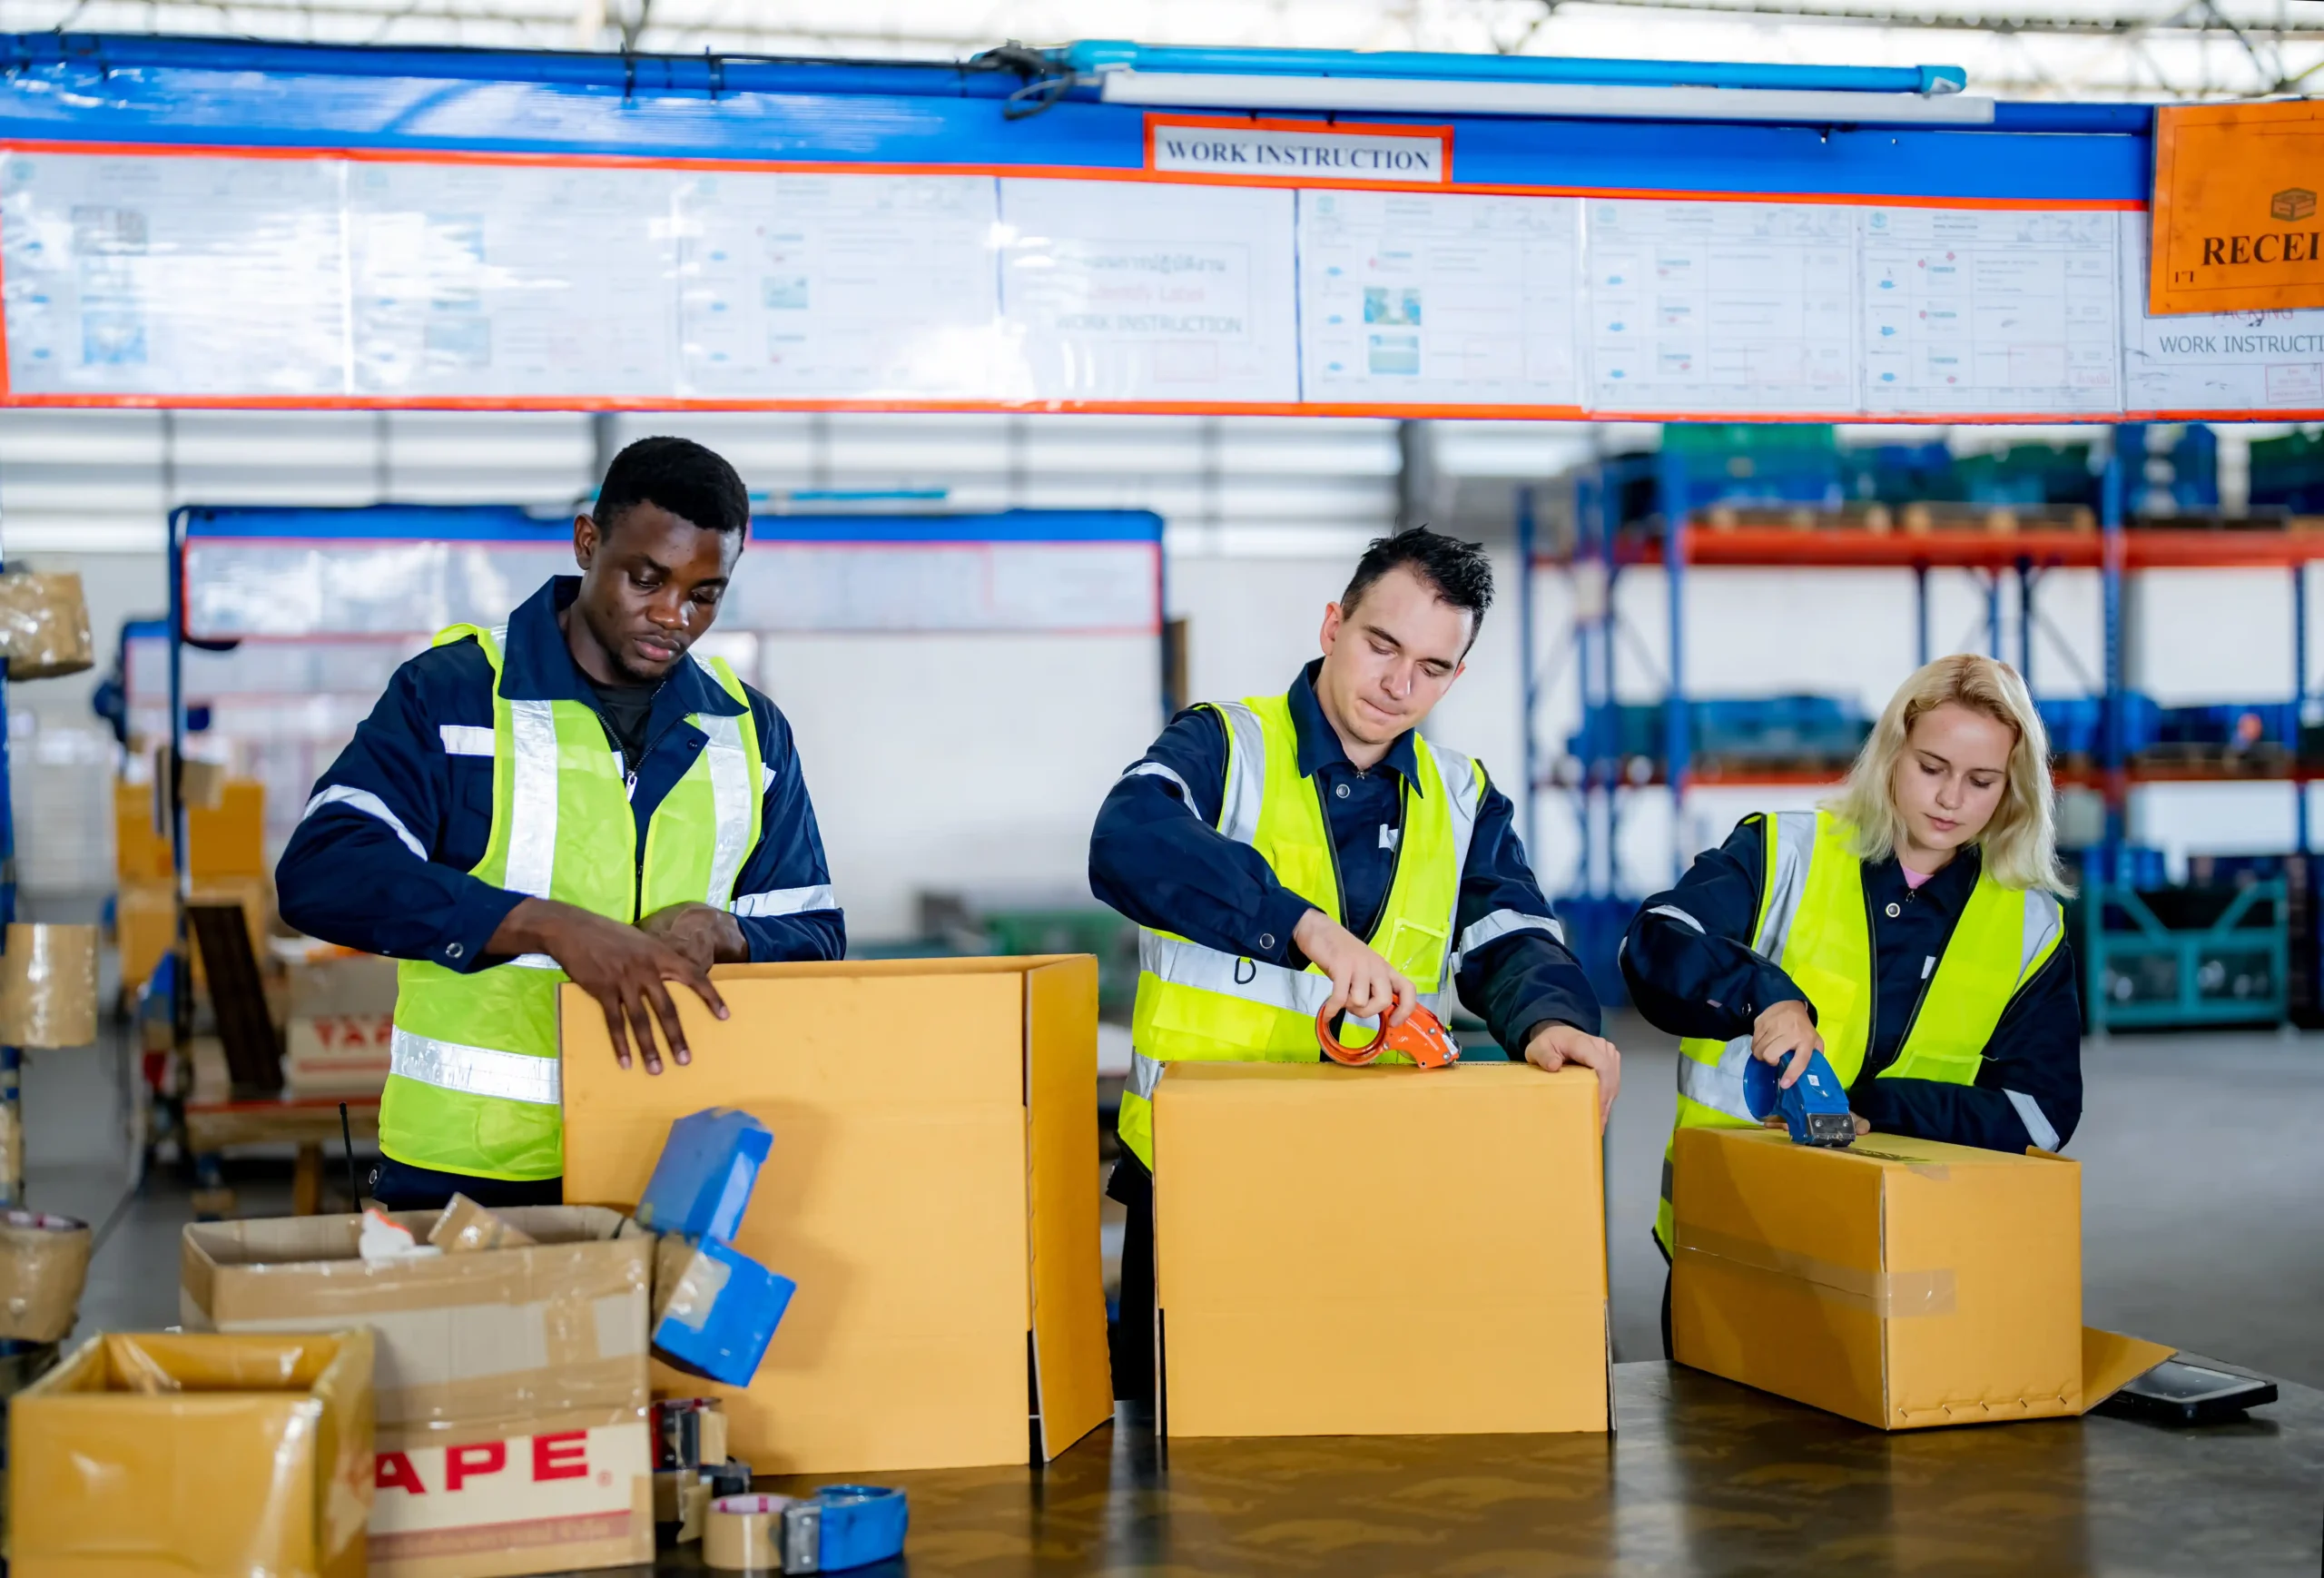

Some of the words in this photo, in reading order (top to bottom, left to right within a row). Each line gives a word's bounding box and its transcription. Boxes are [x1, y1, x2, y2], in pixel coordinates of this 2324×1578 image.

[1166, 140, 1248, 163] WORK
[1256, 144, 1431, 171] INSTRUCTION
[2201, 232, 2321, 266] RECEI
[1056, 312, 1109, 330] WORK
[1117, 312, 1243, 334] INSTRUCTION
[2159, 335, 2218, 353] WORK
[2223, 334, 2324, 353] INSTRUCTI
[374, 1428, 591, 1496] APE
